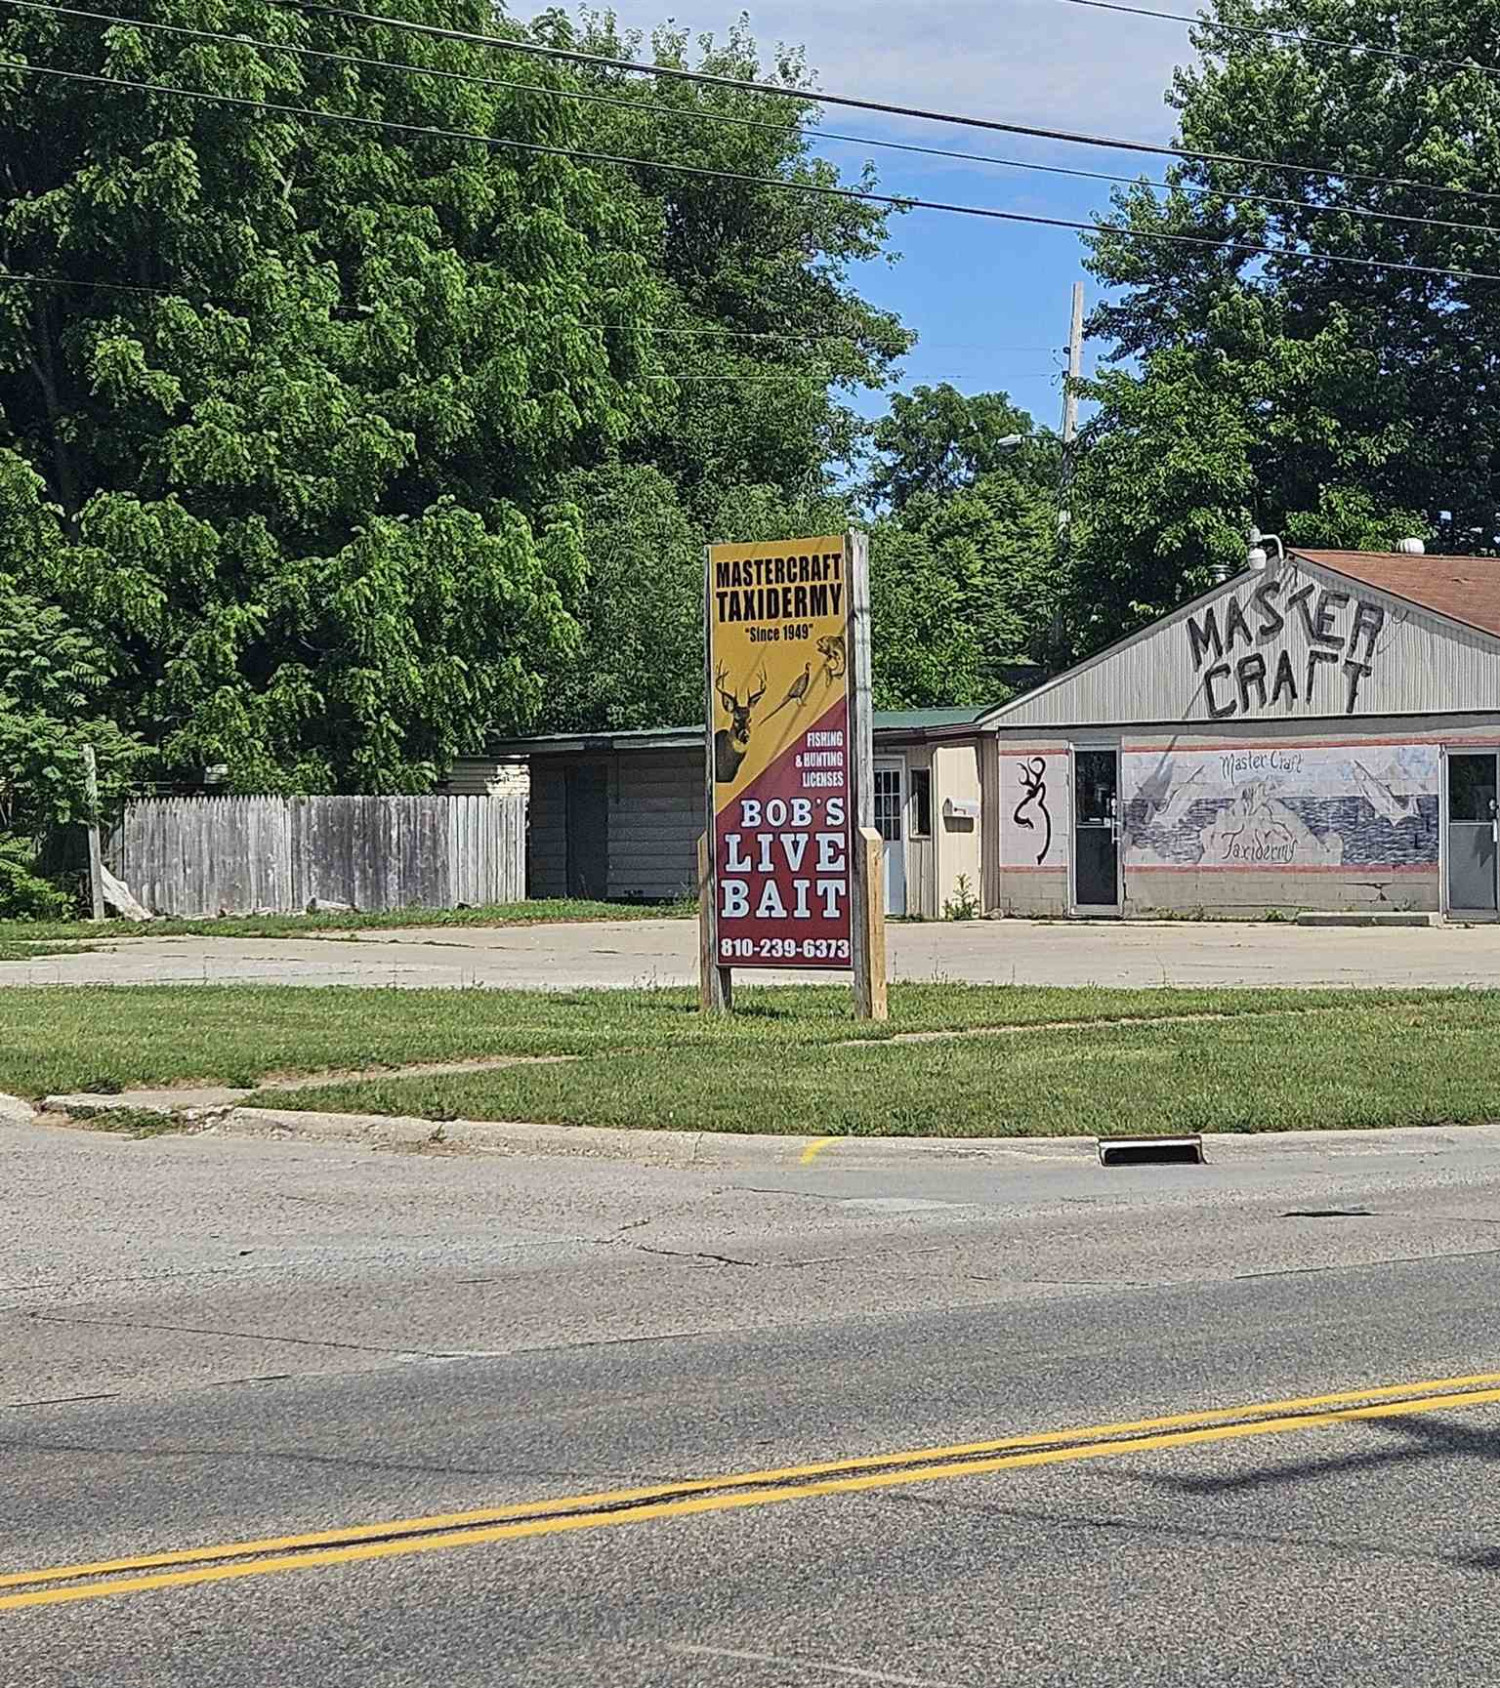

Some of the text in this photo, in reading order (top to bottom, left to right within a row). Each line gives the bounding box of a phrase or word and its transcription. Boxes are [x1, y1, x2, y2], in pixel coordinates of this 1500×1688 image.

[716, 553, 842, 588] MASTERCRAFT
[716, 583, 842, 622] TAXIDERMY
[745, 624, 814, 643] "Since 1949"
[1186, 581, 1384, 672] MASTER
[1204, 650, 1372, 718] CRAFT
[807, 731, 844, 747] FISHING
[795, 751, 844, 768] & HUNTING
[1220, 751, 1304, 785] Master Craft
[802, 771, 844, 787] LICENSES
[741, 797, 845, 828] BOB'S
[724, 833, 845, 872] LIVE
[1221, 824, 1298, 864] Taxidermy
[721, 879, 846, 918] BAIT
[721, 938, 849, 958] 810-239-6373
